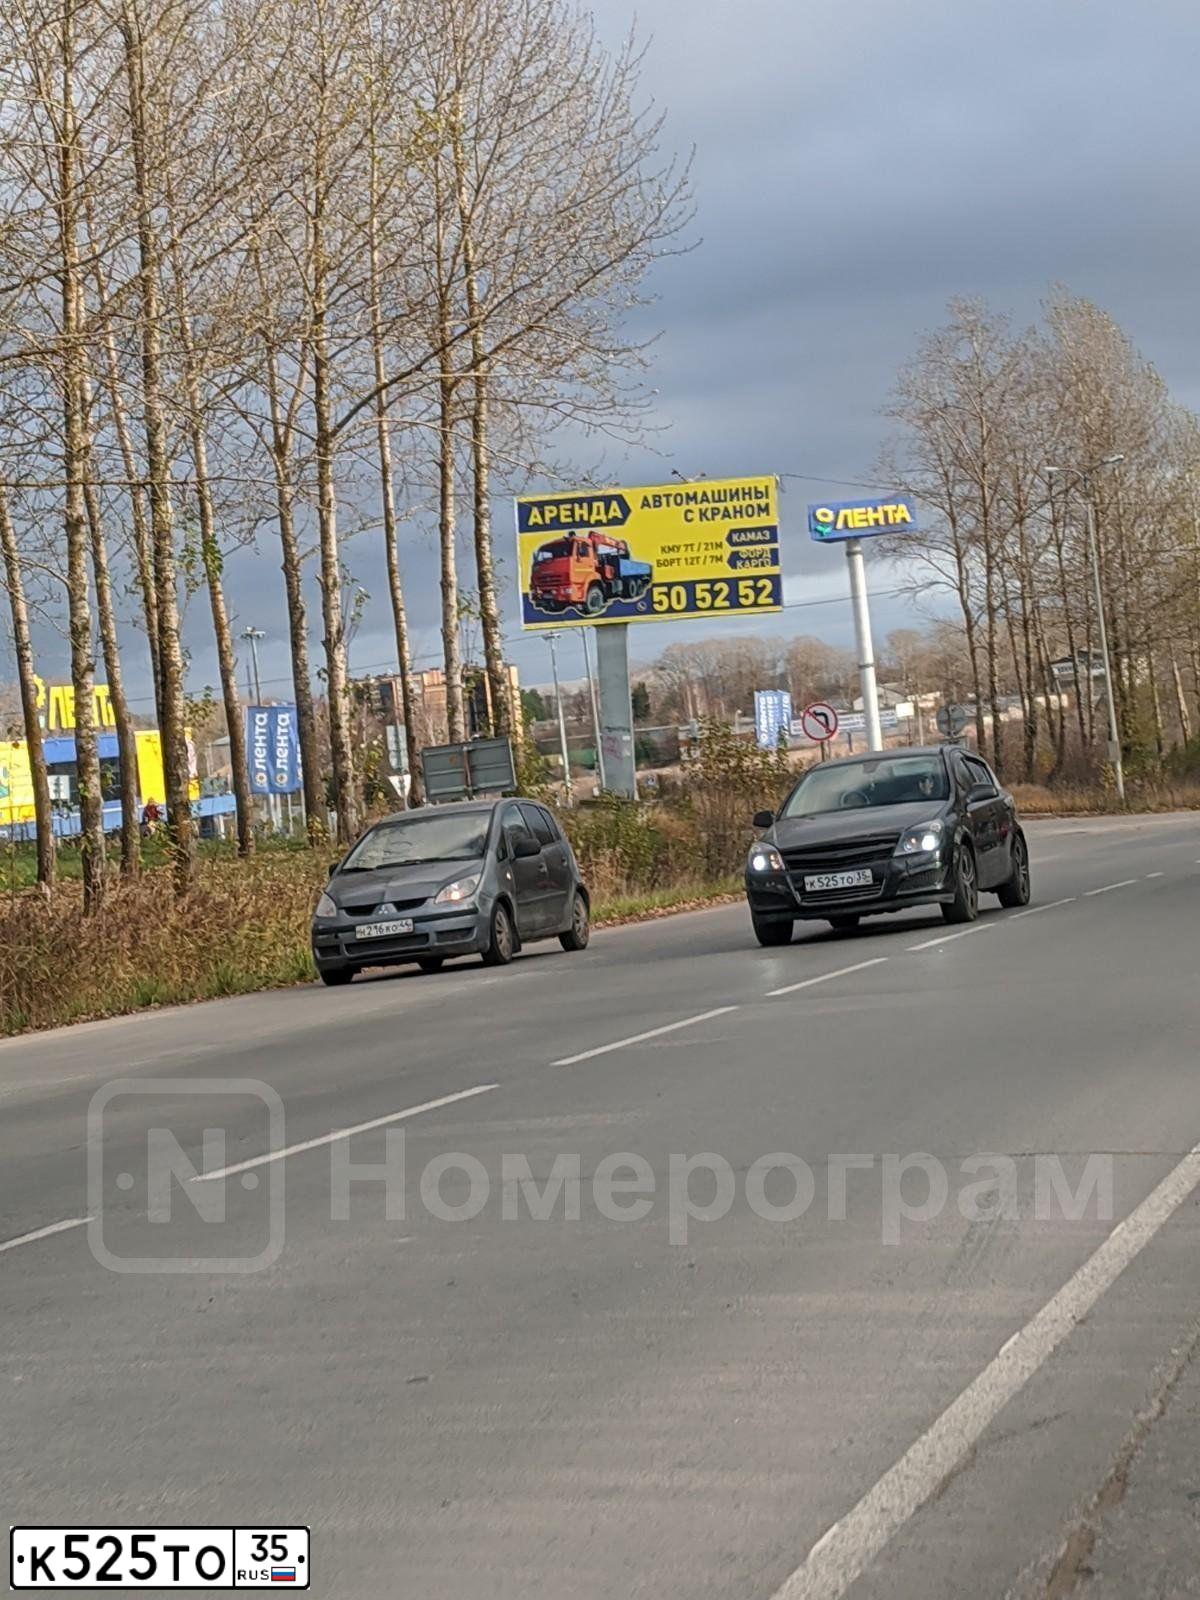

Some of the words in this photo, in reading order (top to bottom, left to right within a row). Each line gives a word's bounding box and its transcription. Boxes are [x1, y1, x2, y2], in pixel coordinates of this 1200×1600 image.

[640, 485, 769, 509] АВТОМАШИНЫ
[527, 500, 623, 526] АРЕНДА
[684, 508, 695, 523] С
[699, 503, 770, 522] КРАНОМ
[836, 503, 913, 529] ЛЕНТА
[731, 530, 770, 543] КАМАЗ
[660, 544, 681, 555] КМУ
[656, 557, 682, 568] БОРТ
[652, 586, 687, 612] 50
[695, 582, 730, 609] 52
[738, 579, 774, 606] 52
[254, 712, 268, 771] лента
[275, 712, 290, 771] лента
